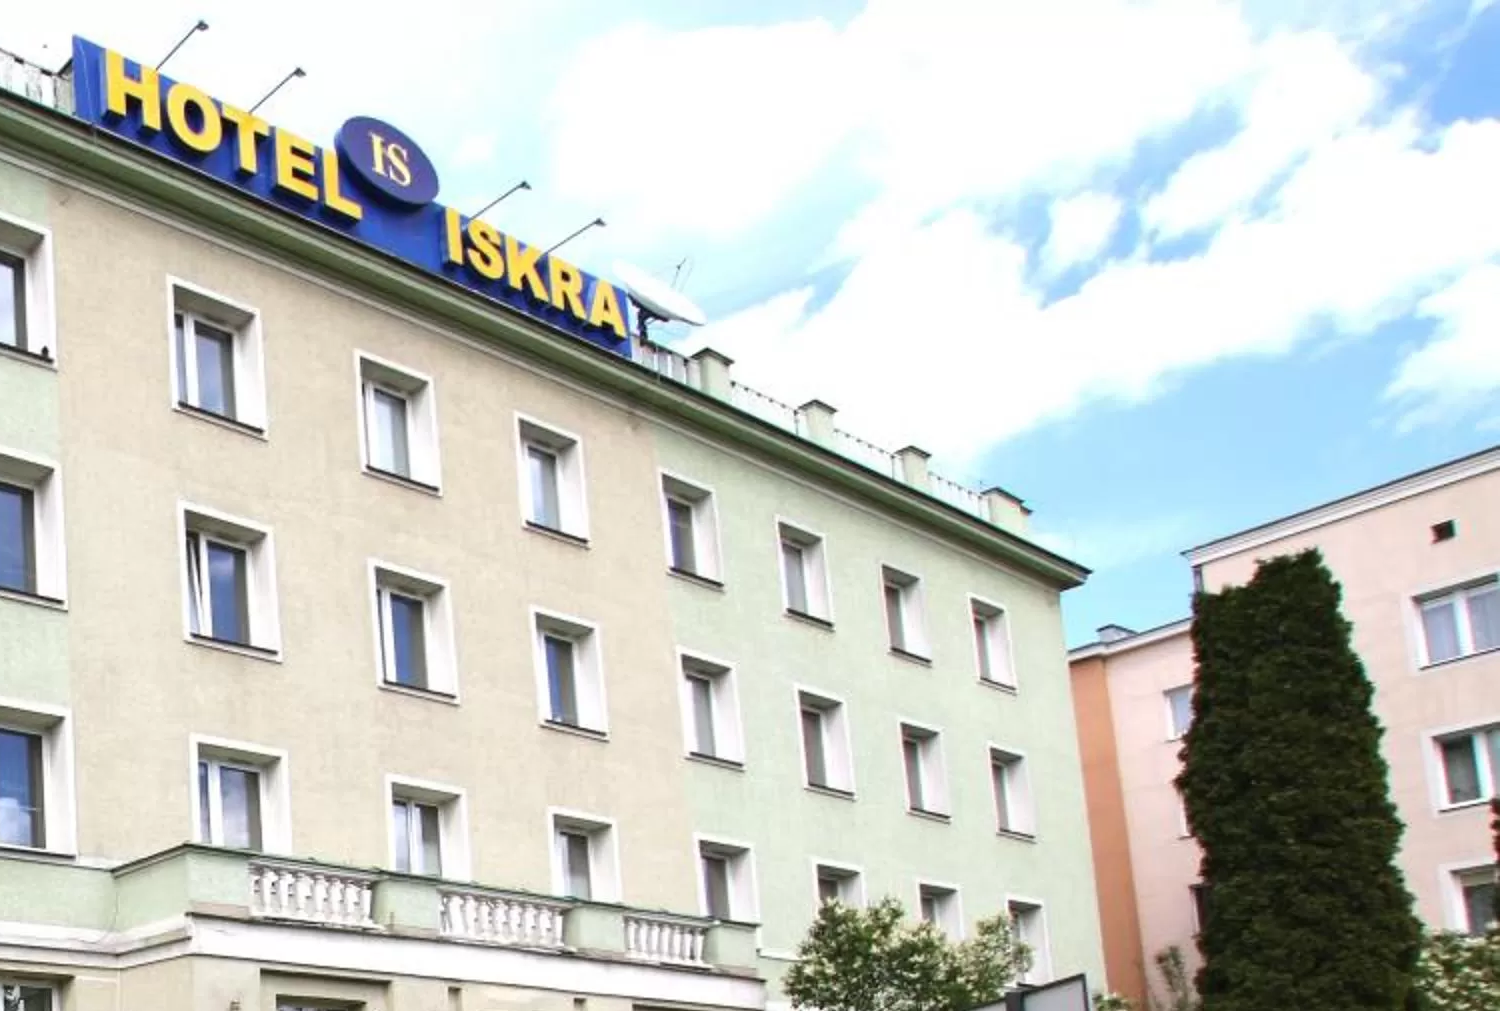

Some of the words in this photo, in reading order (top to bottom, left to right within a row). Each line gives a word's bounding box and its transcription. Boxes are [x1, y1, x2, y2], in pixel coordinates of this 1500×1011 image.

[106, 49, 363, 220] HOTEL
[446, 207, 627, 338] ISKRA
[368, 132, 411, 187] IS
